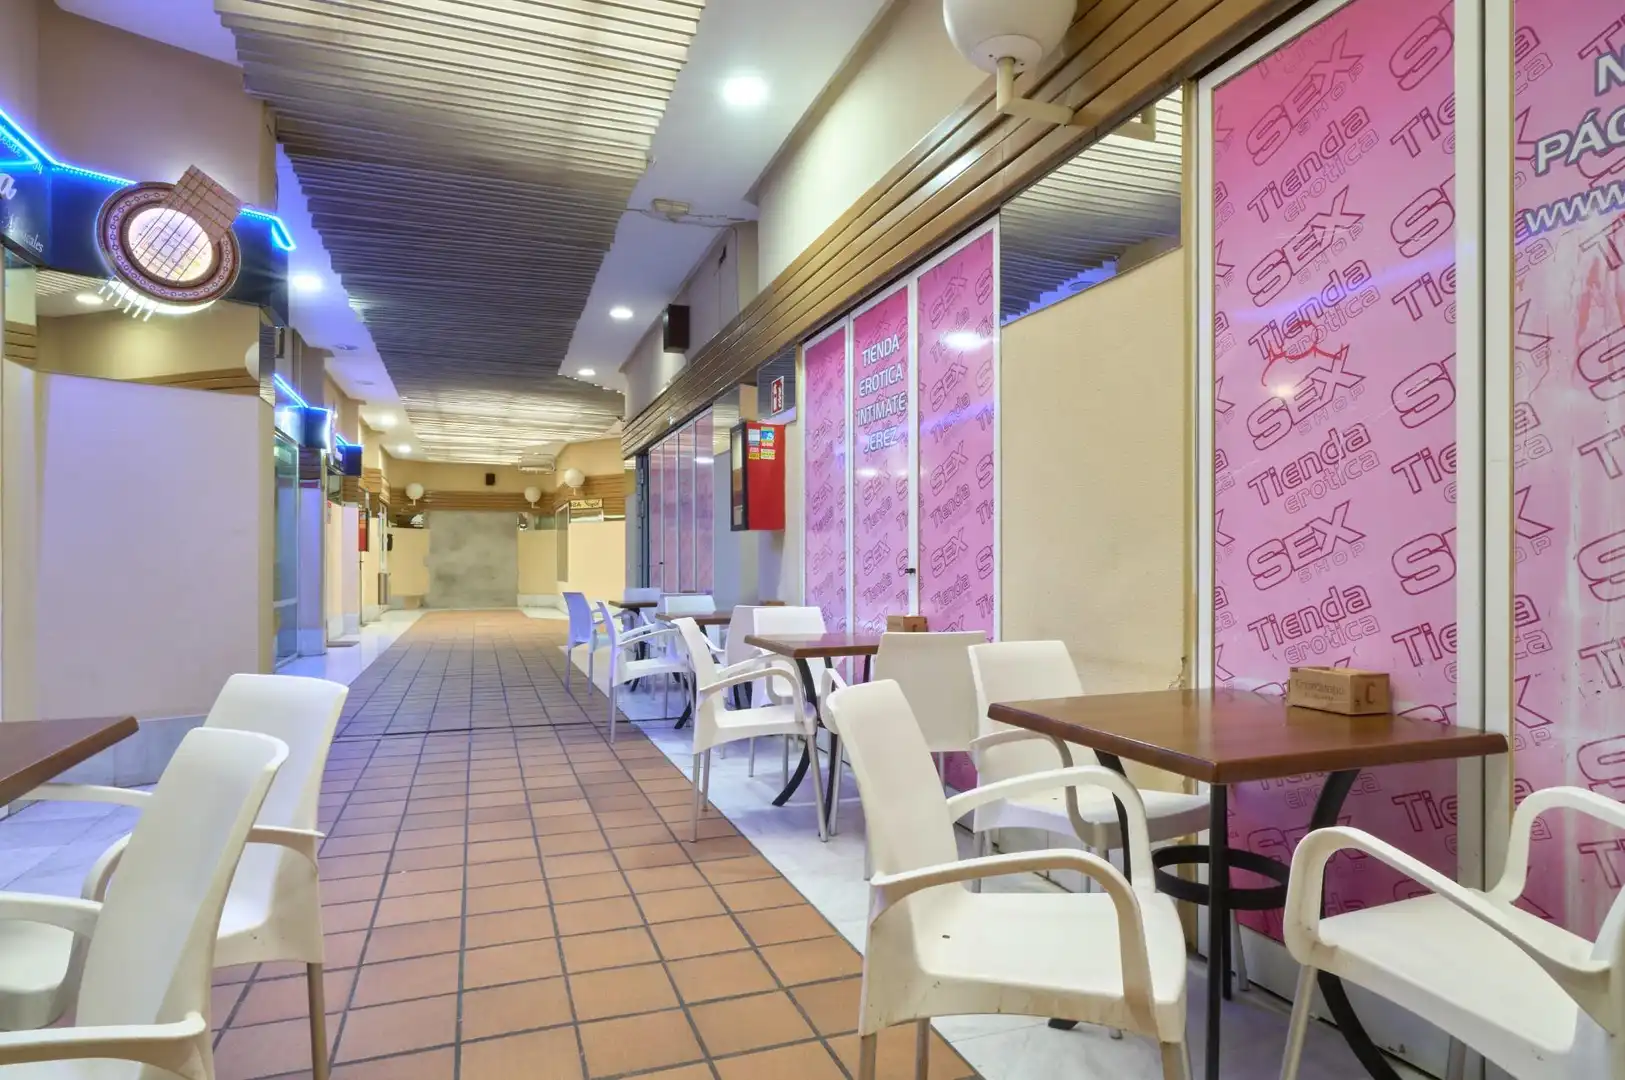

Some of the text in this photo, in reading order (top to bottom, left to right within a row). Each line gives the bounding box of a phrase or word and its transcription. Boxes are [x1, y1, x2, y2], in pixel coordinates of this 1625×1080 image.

[1246, 28, 1364, 167] SEX
[1247, 105, 1371, 223] Tienda
[1283, 128, 1380, 222] erotica
[1246, 185, 1366, 308] SEX
[929, 262, 968, 330] SEX
[1248, 260, 1372, 361] Tienda
[858, 363, 905, 398] EROTICA
[862, 333, 900, 367] TIENDA
[856, 391, 908, 427] INTIMATE
[929, 351, 968, 413] SEX
[1247, 345, 1366, 451] SEX
[863, 426, 898, 454] JEREZ
[930, 442, 969, 497] SEX
[1247, 423, 1371, 506] Tienda
[929, 483, 971, 529] Tienda
[1284, 450, 1380, 514] erotica
[862, 532, 892, 577] SEX
[930, 527, 969, 580] SEX
[1247, 500, 1366, 591] SEX
[930, 574, 971, 613] Tienda
[1247, 585, 1372, 651] Tienda
[1284, 614, 1381, 665] erotica
